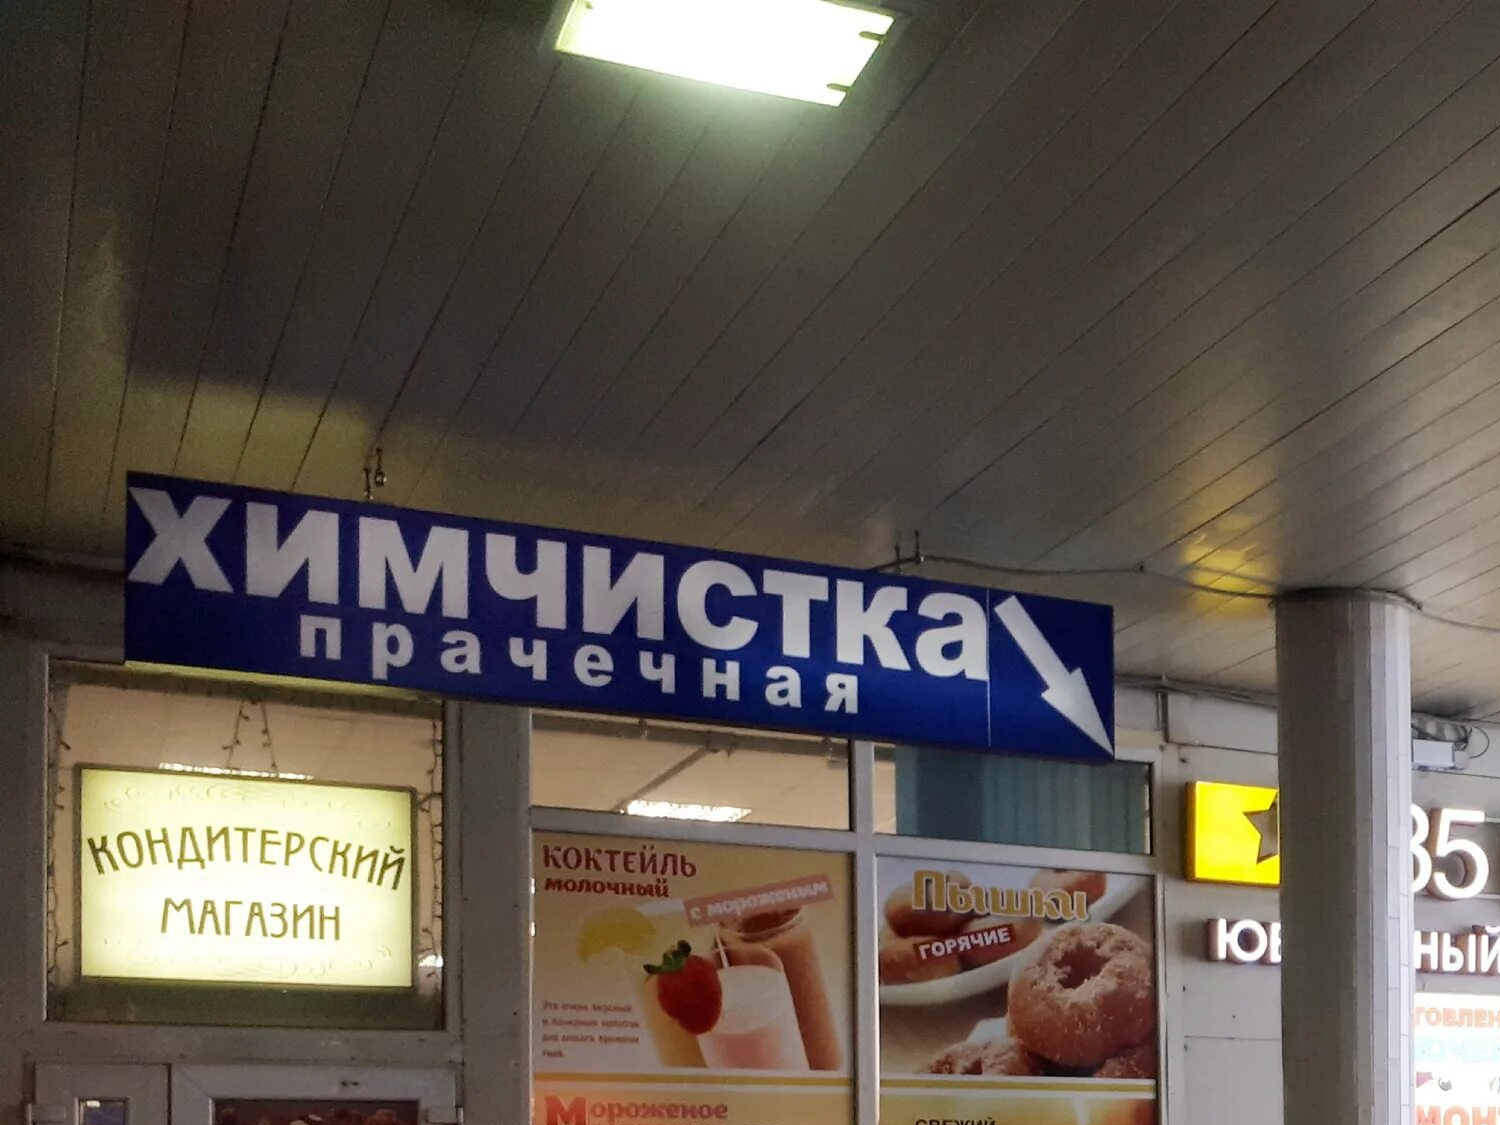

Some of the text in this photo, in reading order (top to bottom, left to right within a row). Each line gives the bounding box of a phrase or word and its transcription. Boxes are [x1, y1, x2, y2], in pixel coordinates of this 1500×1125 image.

[299, 611, 860, 715] прачечная
[87, 826, 407, 892] КОНДИТЕРСКИЙ
[542, 844, 697, 878] КОКТЕЙЛЬ
[544, 877, 671, 898] молочный
[912, 868, 1089, 922] Пышки
[160, 895, 342, 941] МАГАЗИН
[918, 926, 1011, 961] ГОРЯЧИЕ
